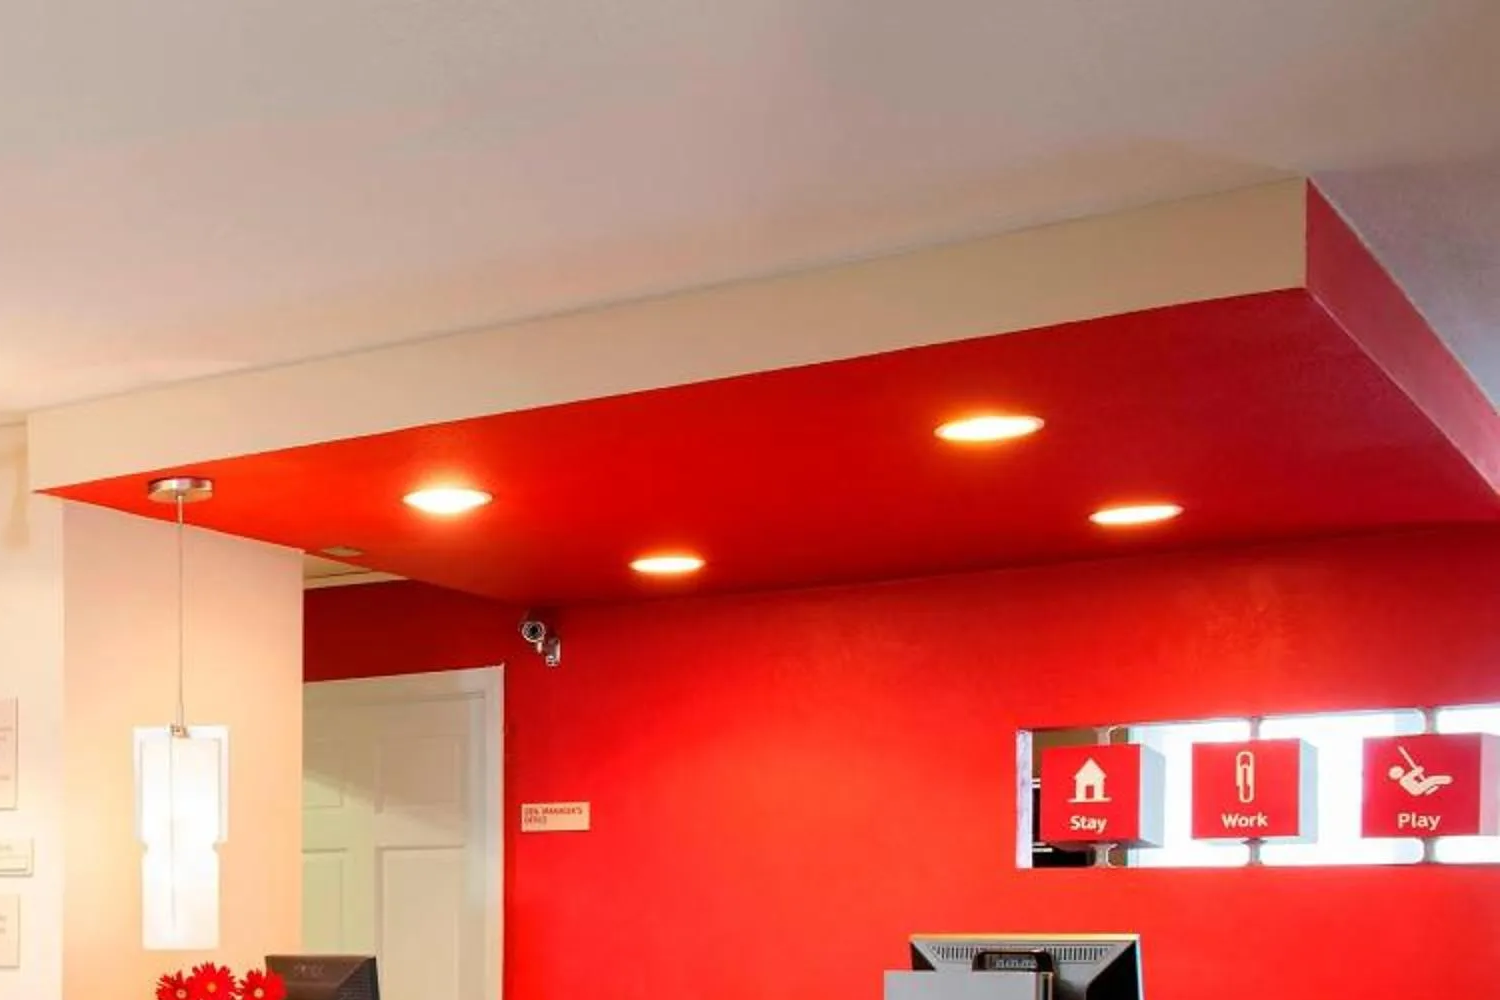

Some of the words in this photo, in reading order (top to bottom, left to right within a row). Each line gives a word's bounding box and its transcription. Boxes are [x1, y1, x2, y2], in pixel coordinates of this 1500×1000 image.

[1068, 814, 1107, 836] Stay
[1221, 812, 1268, 829] Work
[1397, 811, 1441, 832] Play
